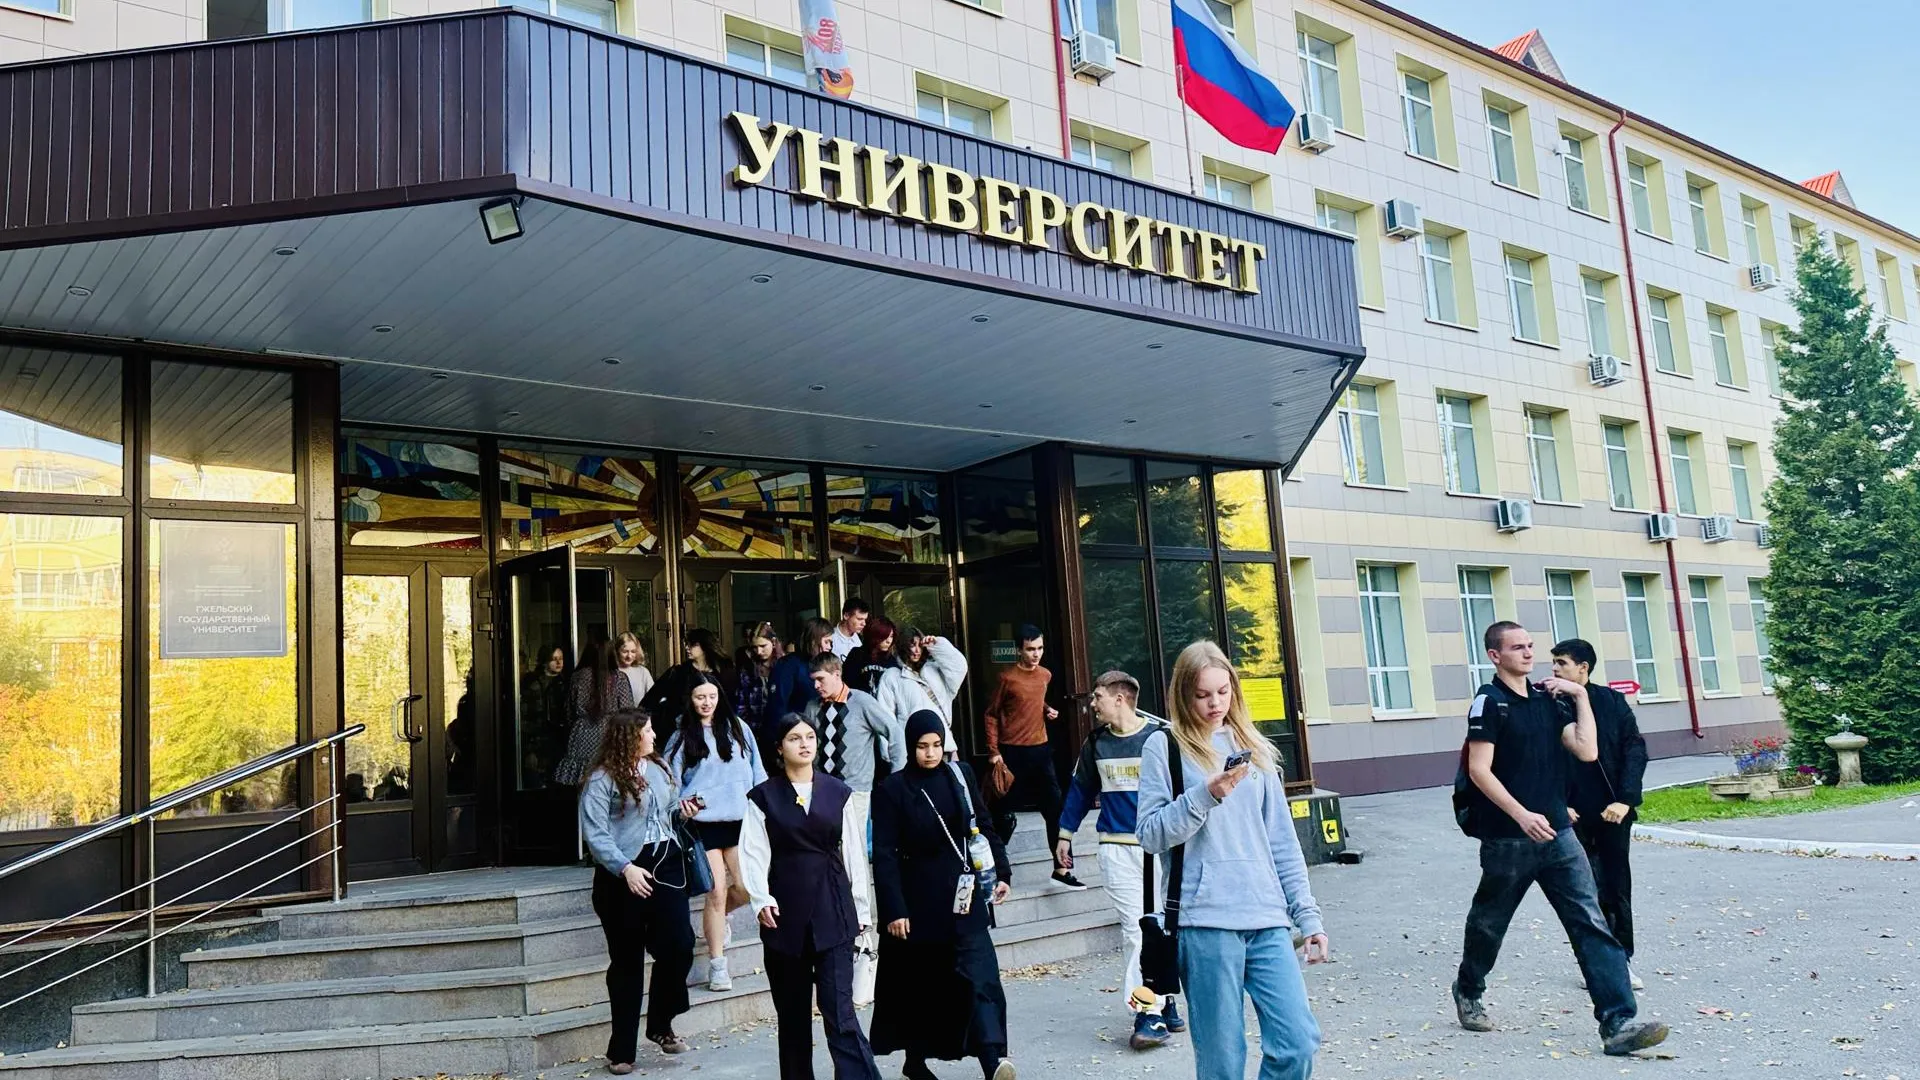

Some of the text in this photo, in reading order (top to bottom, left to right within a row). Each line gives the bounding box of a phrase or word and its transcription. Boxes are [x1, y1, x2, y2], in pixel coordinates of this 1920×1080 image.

[728, 111, 1266, 294] УНИВЕРСИТЕТ
[196, 605, 253, 613] ГЖЕЛЬСКИЙ
[178, 614, 271, 623] ГОСУДАРСТВЕННЫЙ
[192, 625, 257, 634] УНИВЕРСИТЕТ
